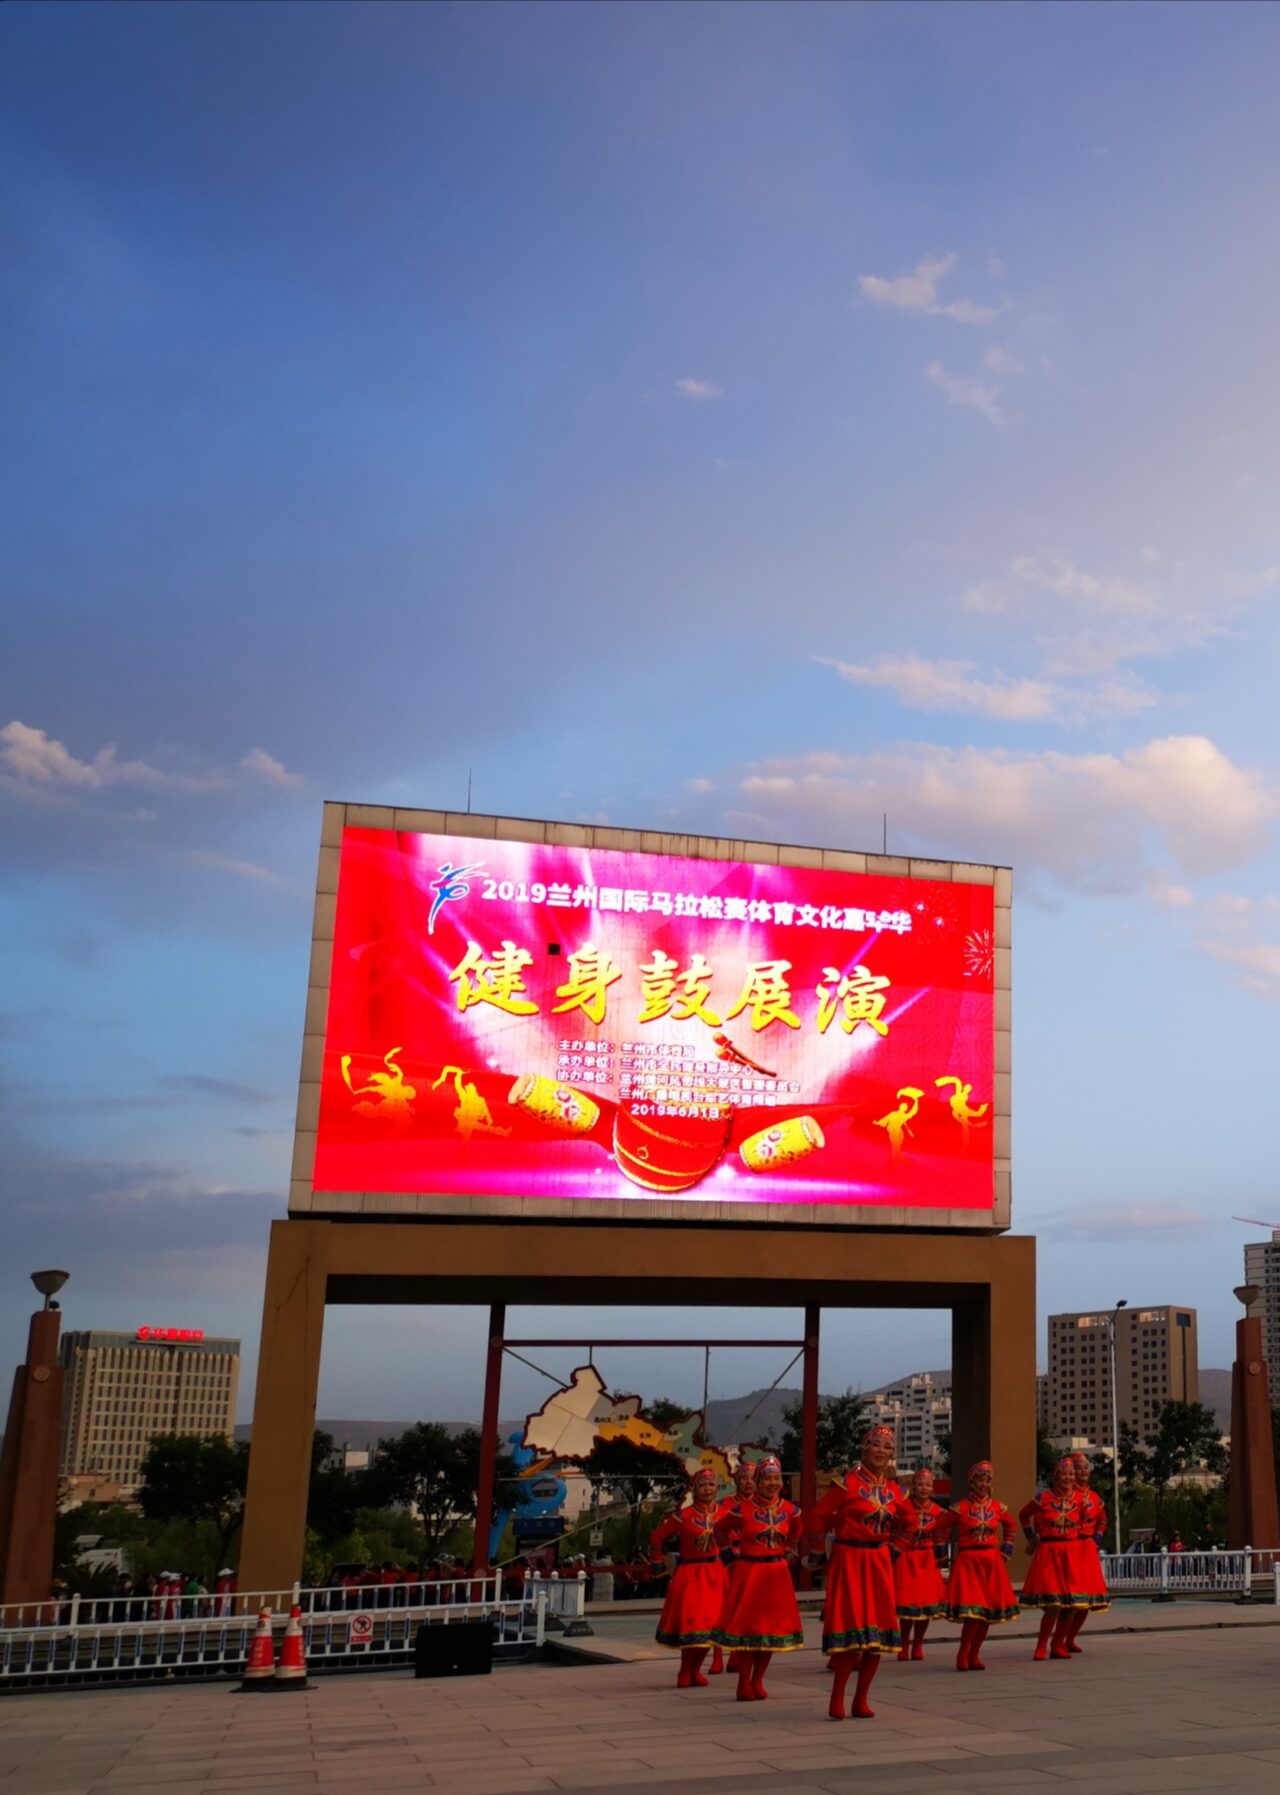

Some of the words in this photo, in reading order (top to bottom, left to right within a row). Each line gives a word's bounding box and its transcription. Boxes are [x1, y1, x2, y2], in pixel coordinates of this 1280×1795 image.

[449, 940, 891, 1036] 健身鼓展演
[631, 1103, 720, 1119] 2019年6月1日
